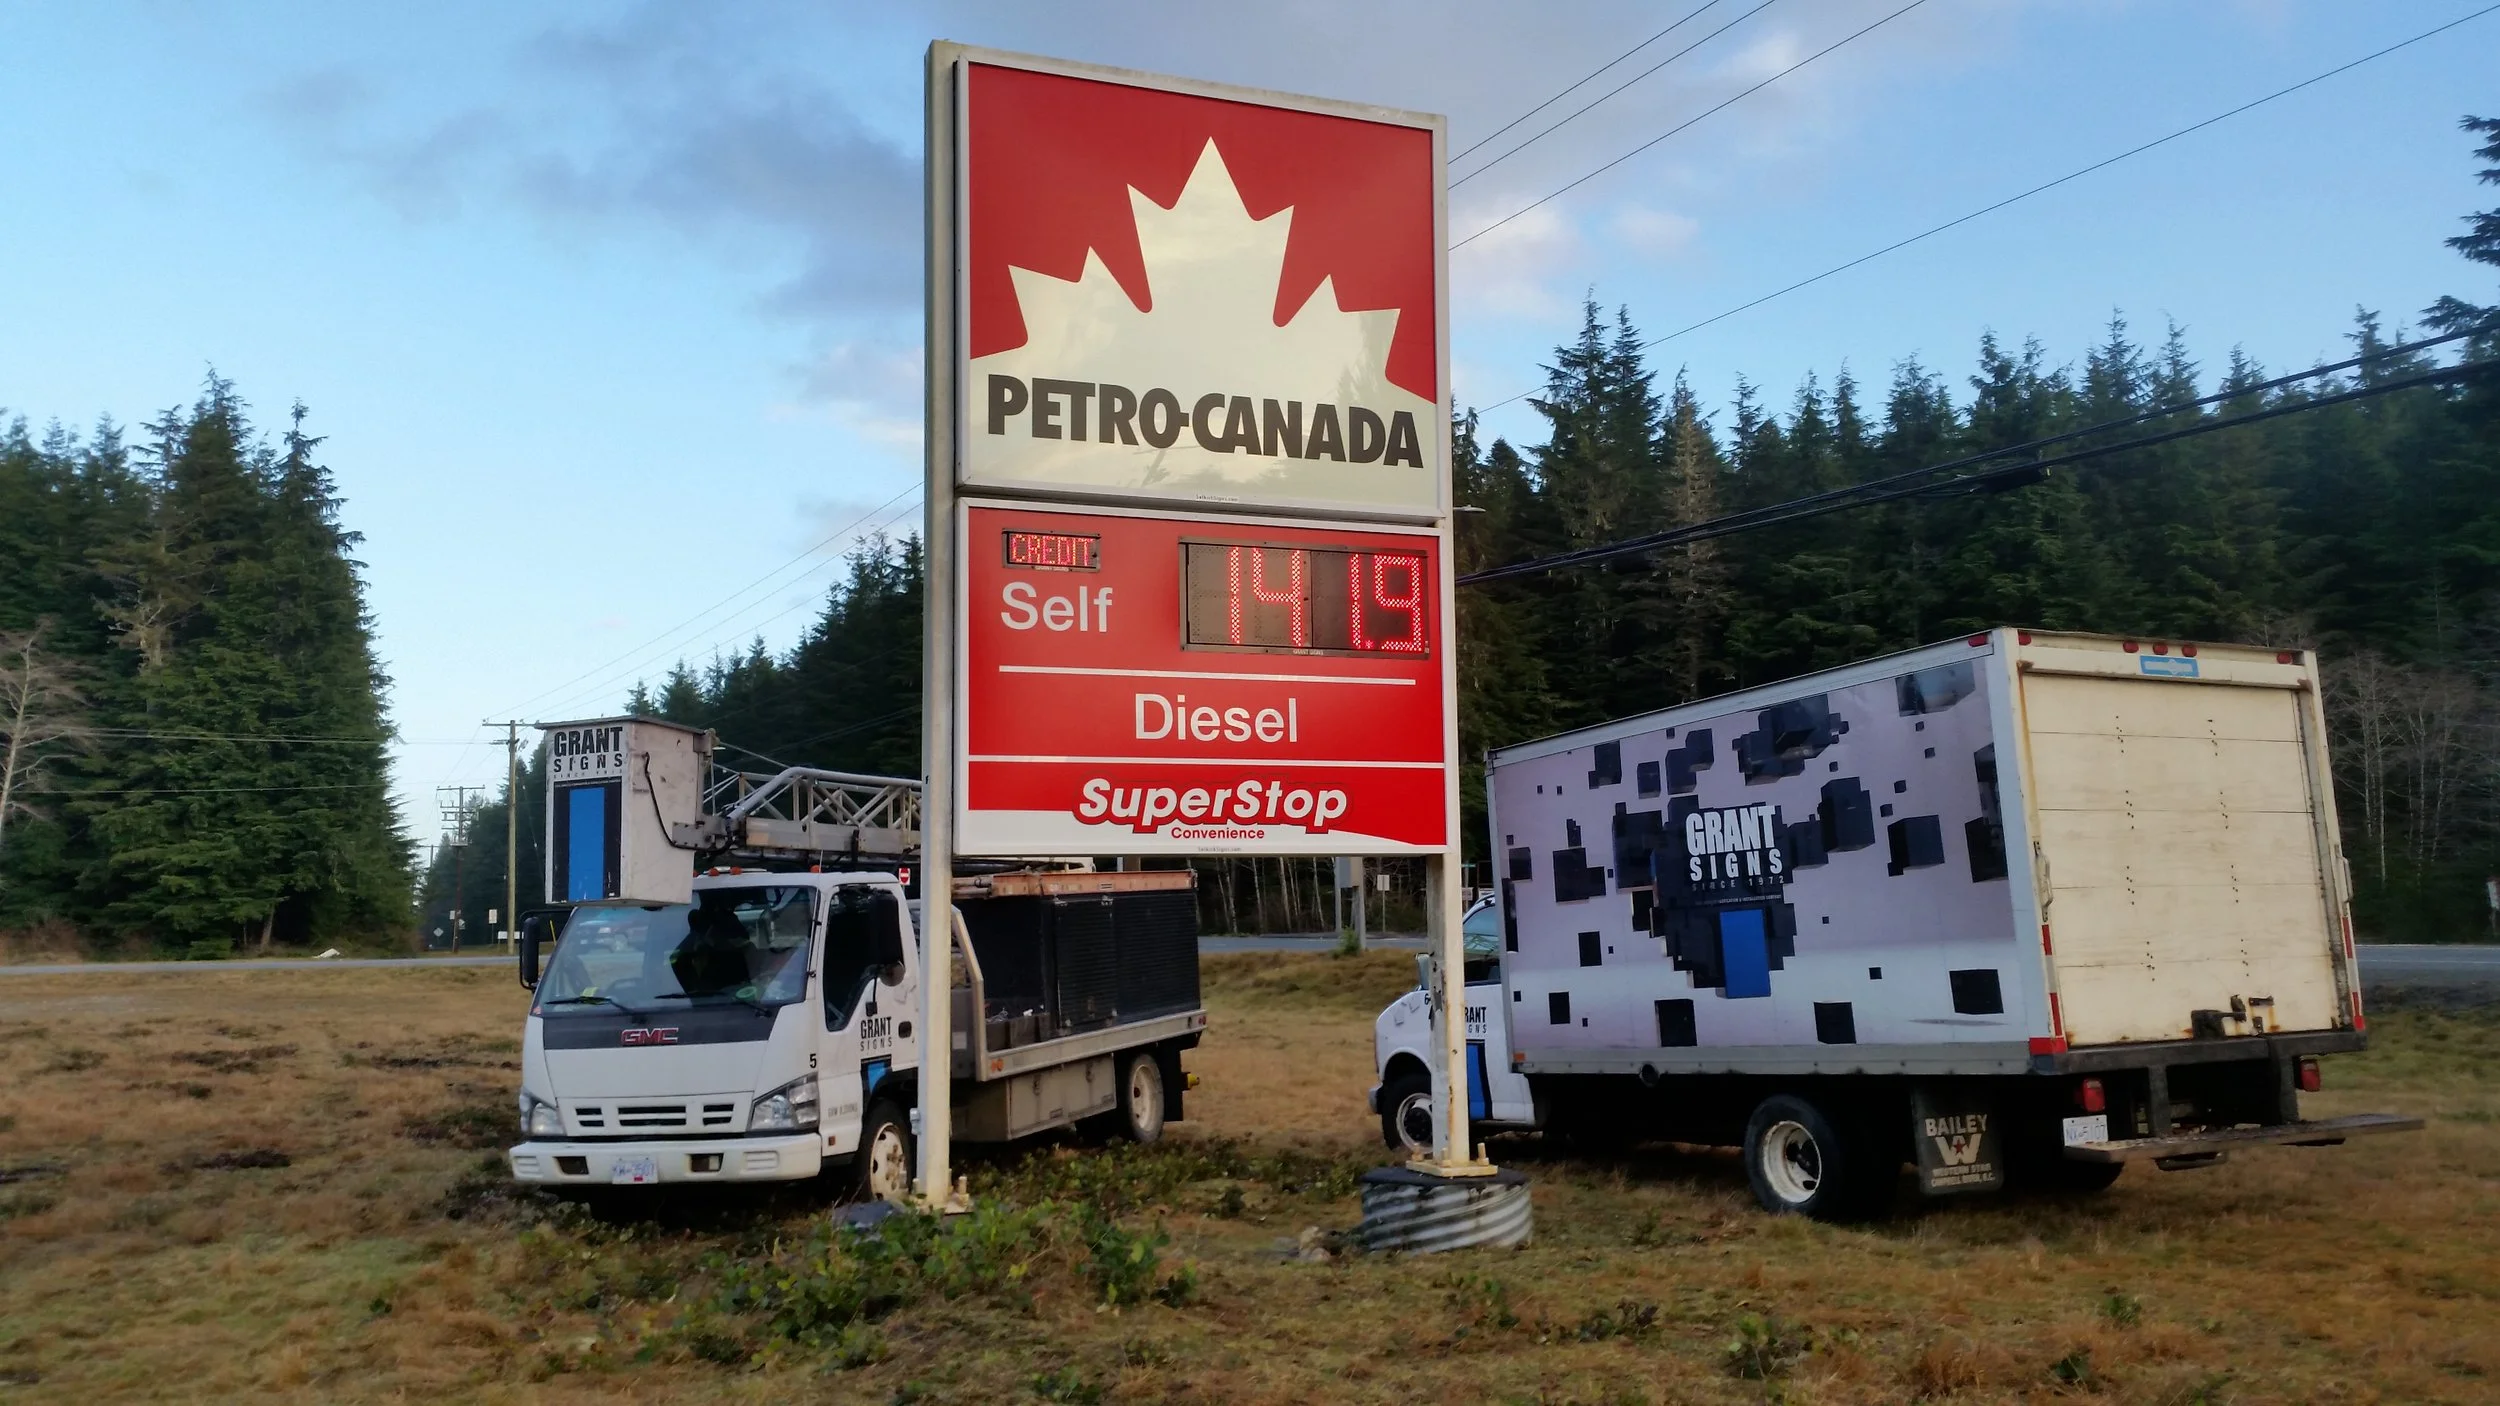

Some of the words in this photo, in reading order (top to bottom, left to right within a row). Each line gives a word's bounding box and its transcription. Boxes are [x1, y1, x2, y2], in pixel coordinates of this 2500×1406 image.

[988, 373, 1424, 469] PETRO-CANADA
[1012, 533, 1094, 566] CREDIT
[1001, 581, 1113, 633] Self
[1135, 692, 1298, 743] Diesel
[554, 726, 623, 757] GRANT
[553, 753, 623, 772] SIGNS
[1079, 778, 1347, 827] SuperStop
[1170, 827, 1265, 839] Convenience
[1685, 805, 1776, 856] GRANT
[1689, 848, 1783, 881] SIGNS
[1748, 876, 1785, 887] 1972
[1464, 1006, 1487, 1023] RANT
[621, 1027, 679, 1046] GMC
[860, 1016, 892, 1039] GRANT
[860, 1037, 893, 1051] SIGNS
[809, 1053, 817, 1069] 5
[1925, 1114, 1988, 1137] BAILEY
